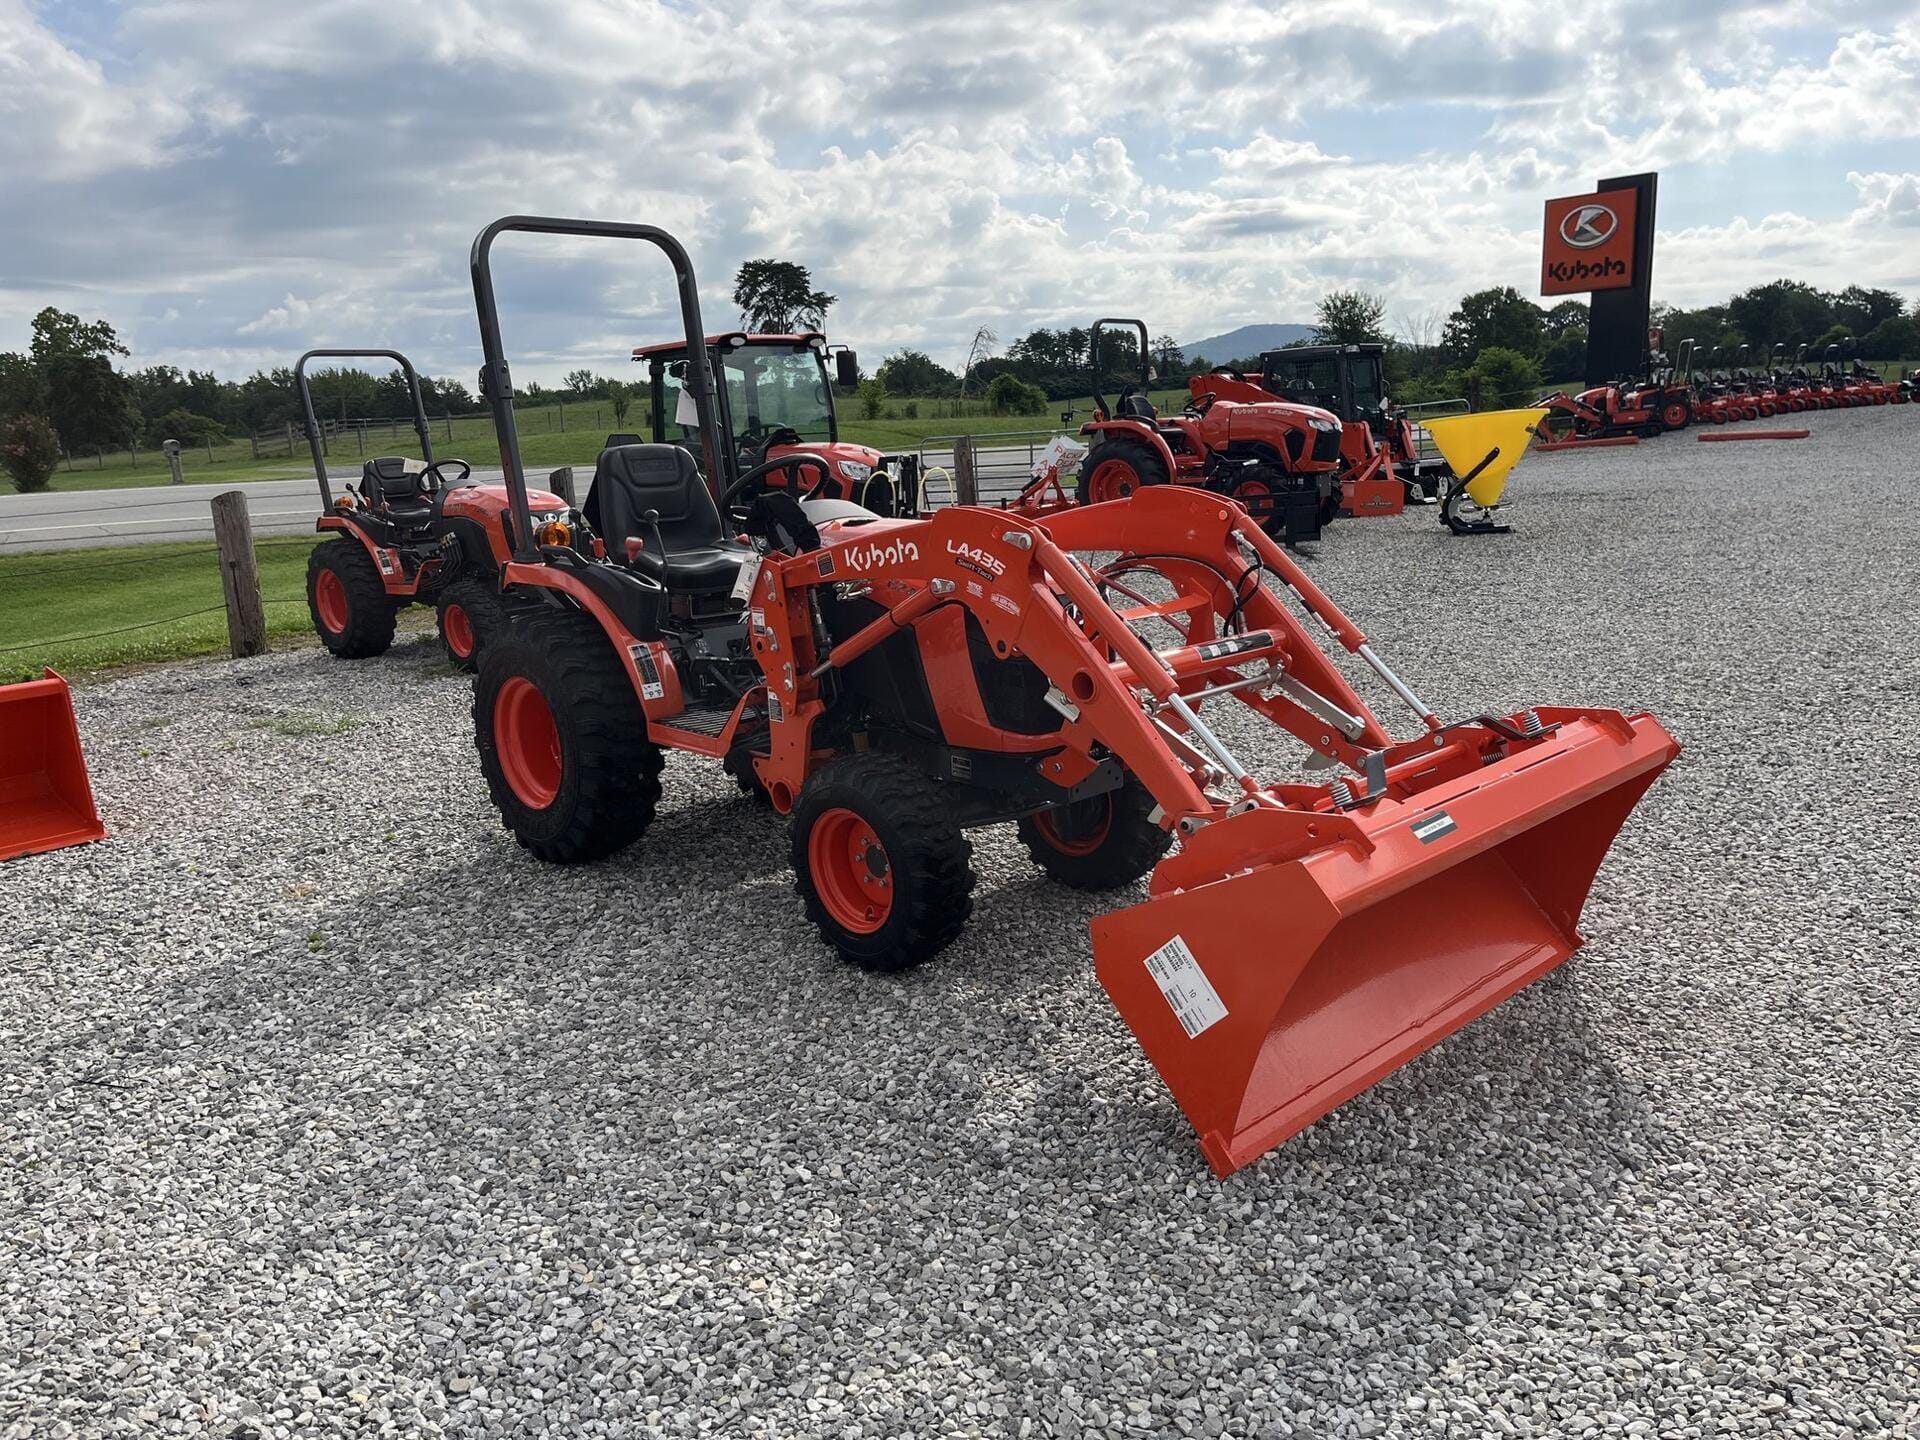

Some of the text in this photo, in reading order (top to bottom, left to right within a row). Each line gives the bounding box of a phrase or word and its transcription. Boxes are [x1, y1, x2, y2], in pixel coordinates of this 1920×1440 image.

[1548, 256, 1626, 282] Kubota
[844, 537, 919, 572] Kubota
[946, 539, 1007, 576] LA435
[1188, 988, 1197, 998] 10
